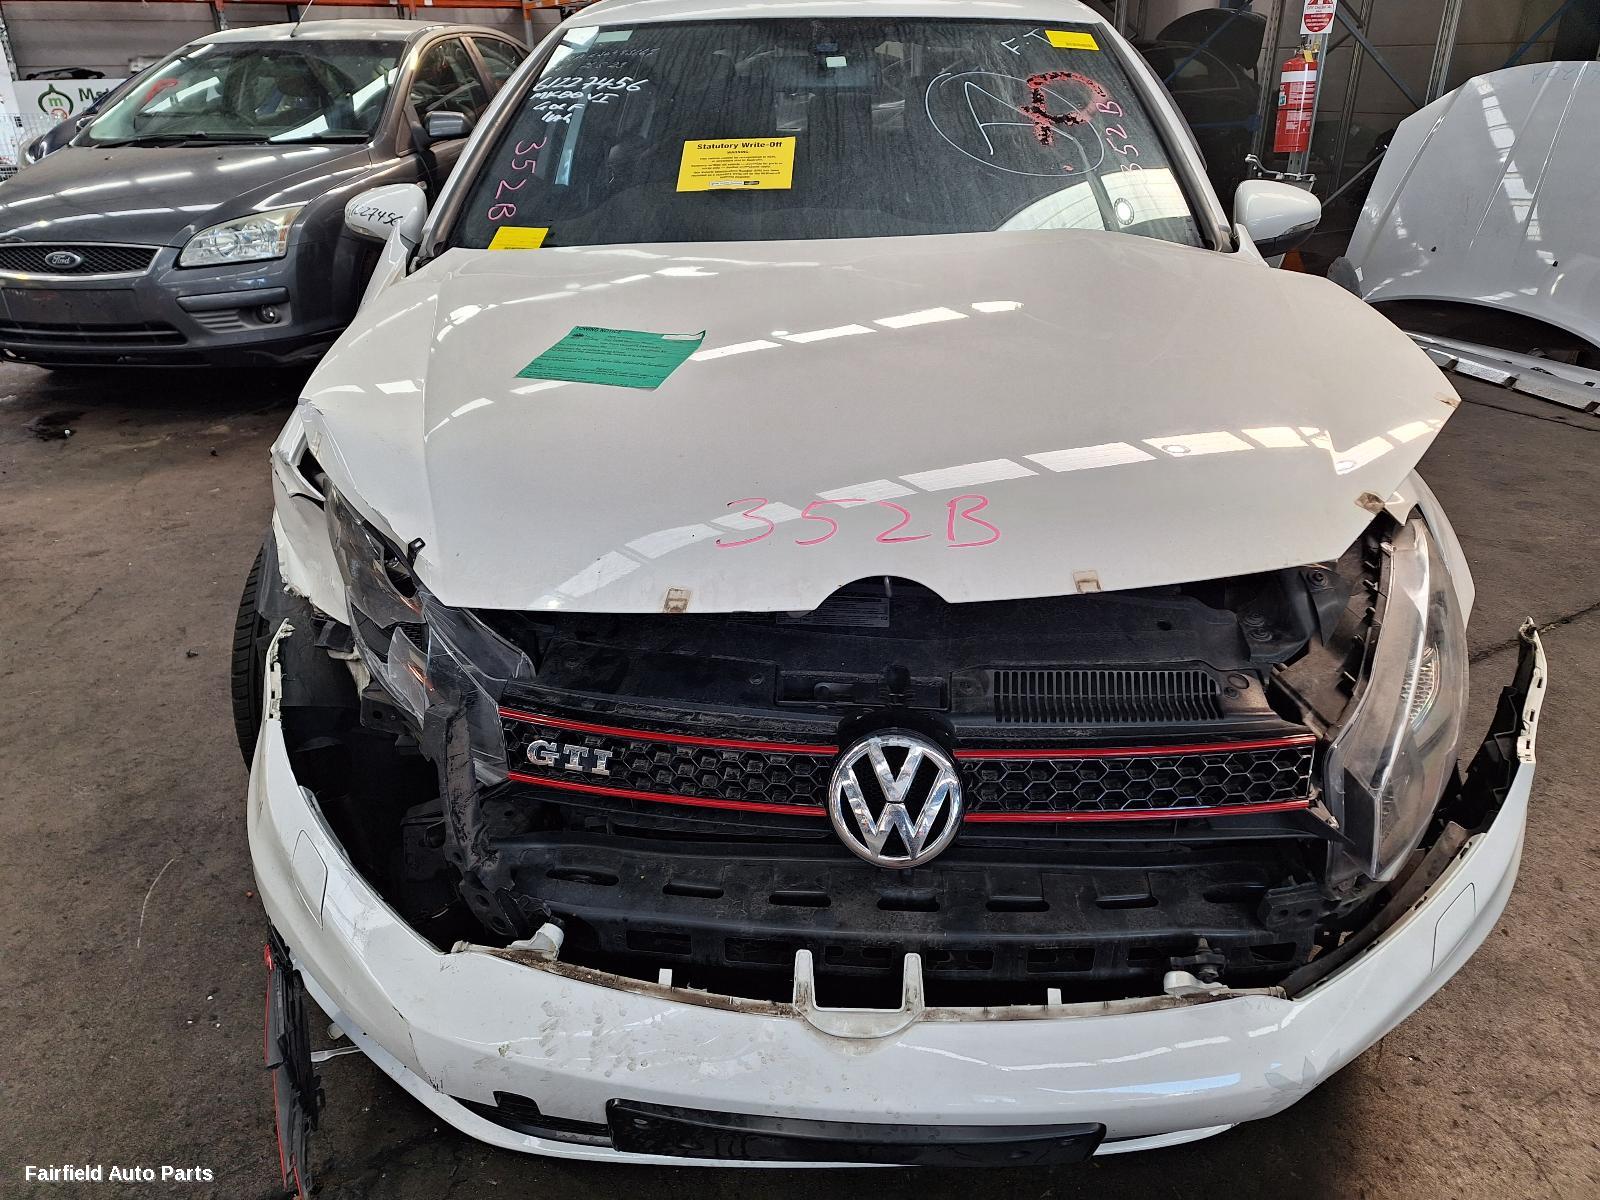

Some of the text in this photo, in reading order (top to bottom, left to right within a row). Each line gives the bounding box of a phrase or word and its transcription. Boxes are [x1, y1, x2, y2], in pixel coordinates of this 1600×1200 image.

[697, 141, 783, 151] Statutory Write-Off
[51, 254, 71, 264] Ford
[715, 494, 1001, 548] 352B
[527, 739, 613, 776] GTI
